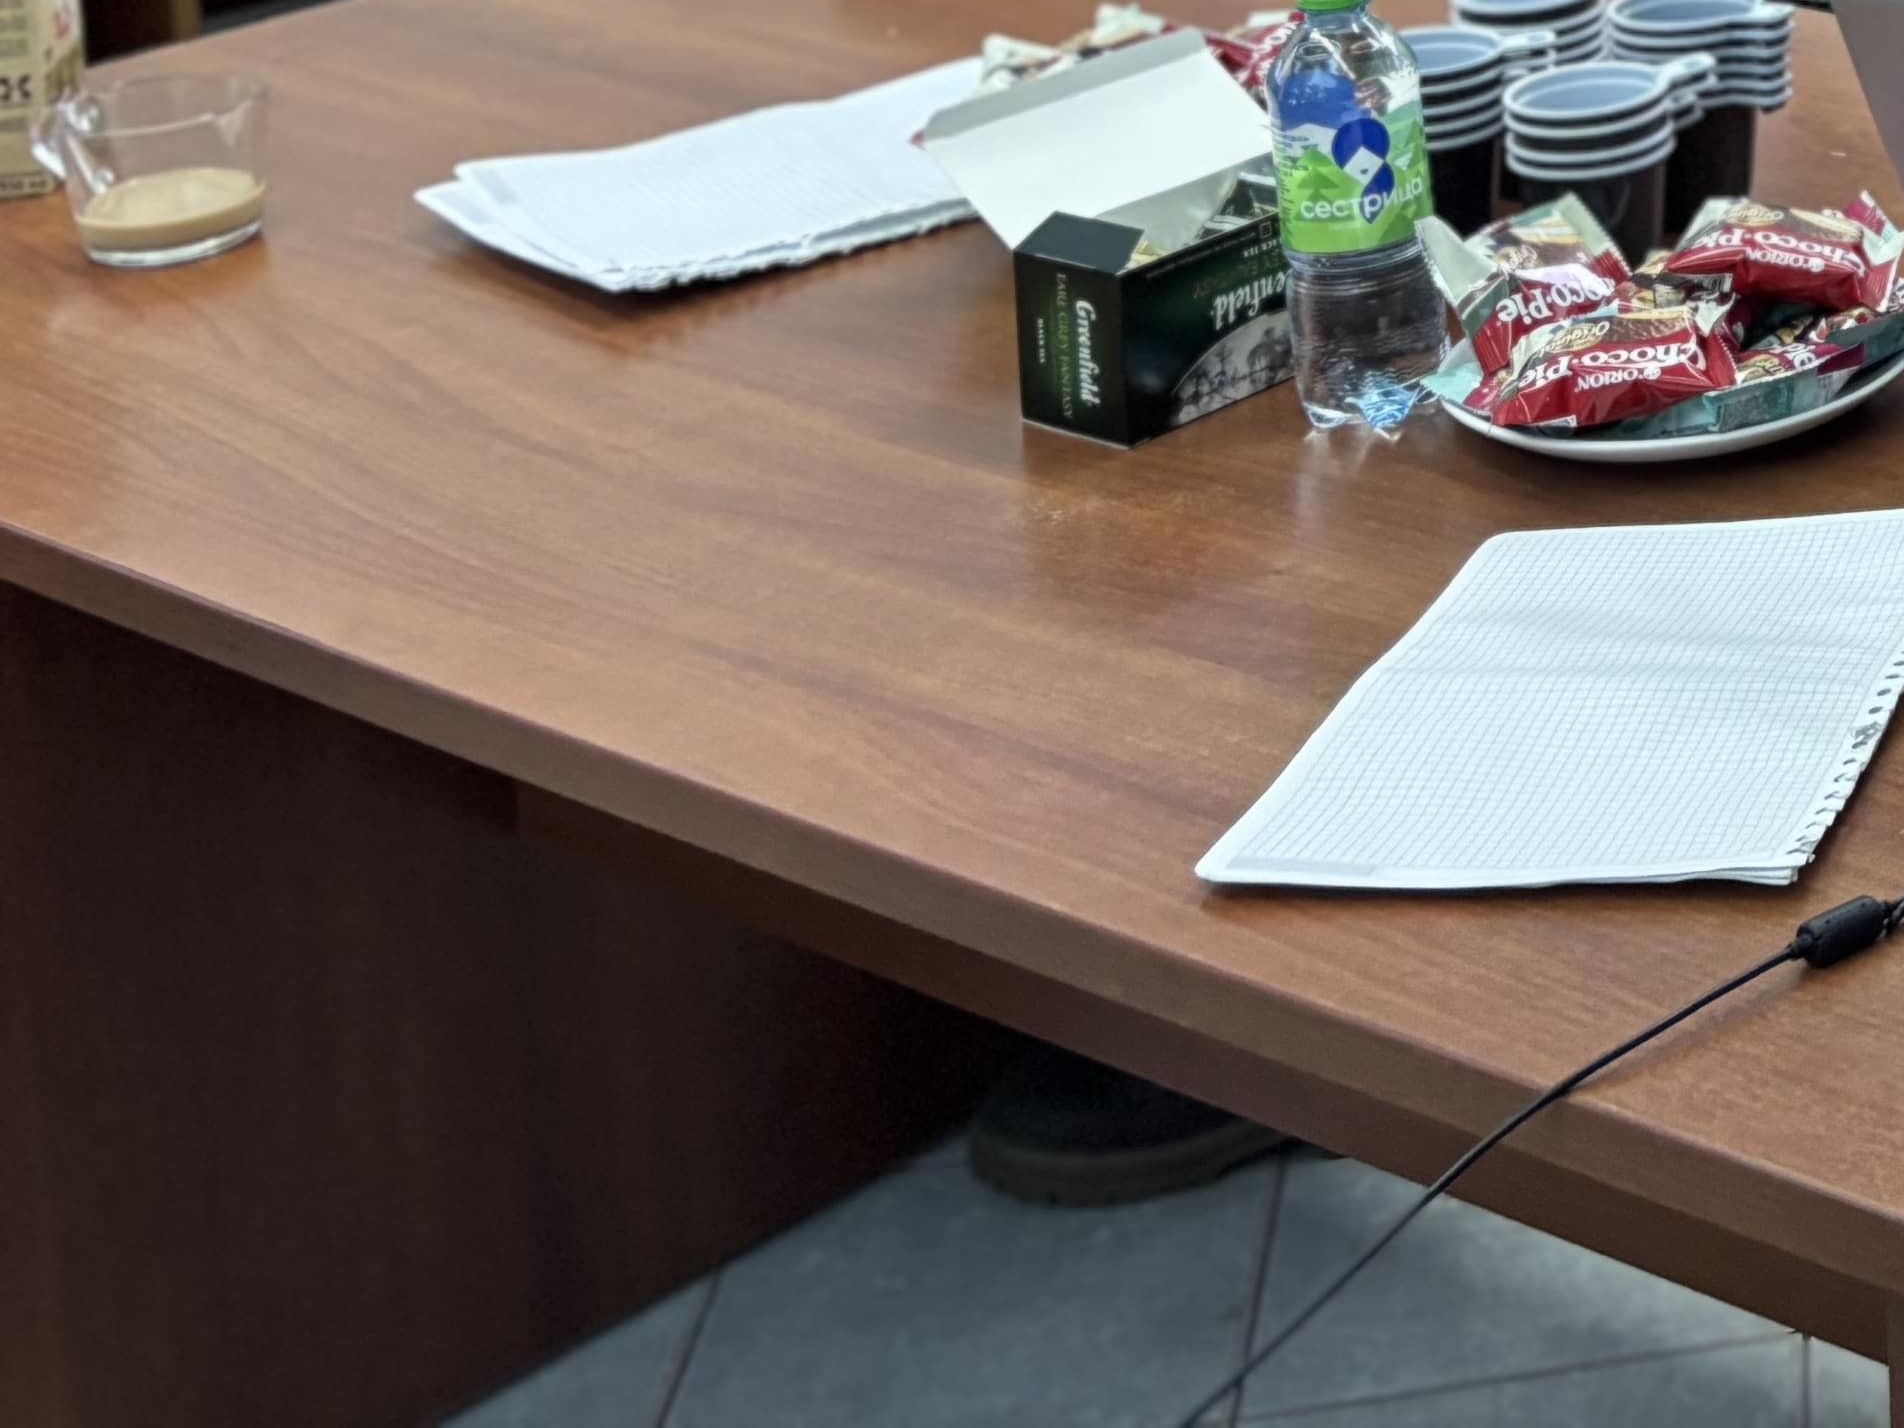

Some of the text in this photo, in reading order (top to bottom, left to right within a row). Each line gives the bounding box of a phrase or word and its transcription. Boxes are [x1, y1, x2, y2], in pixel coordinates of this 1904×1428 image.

[1301, 177, 1423, 219] сестрица
[1212, 269, 1289, 331] enfield
[1057, 311, 1070, 352] GREY
[1075, 299, 1101, 407] Greenfield
[1059, 355, 1073, 419] FANTASY
[1579, 367, 1639, 392] ORION
